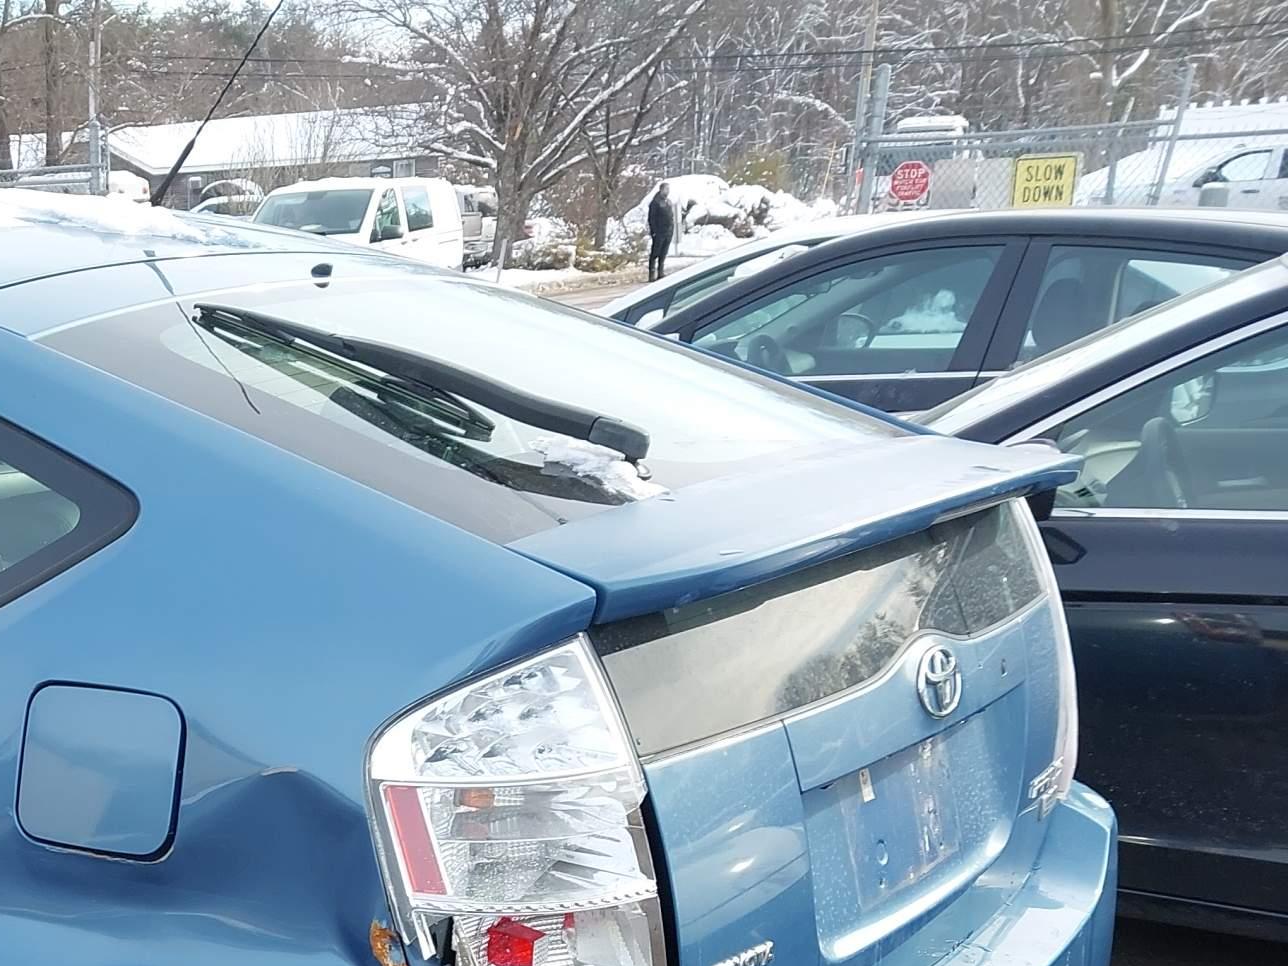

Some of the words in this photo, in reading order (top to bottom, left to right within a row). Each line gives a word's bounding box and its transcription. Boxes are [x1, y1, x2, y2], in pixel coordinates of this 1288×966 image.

[897, 168, 925, 179] STOP
[1025, 163, 1065, 182] SLOW
[1022, 184, 1064, 203] DOWN
